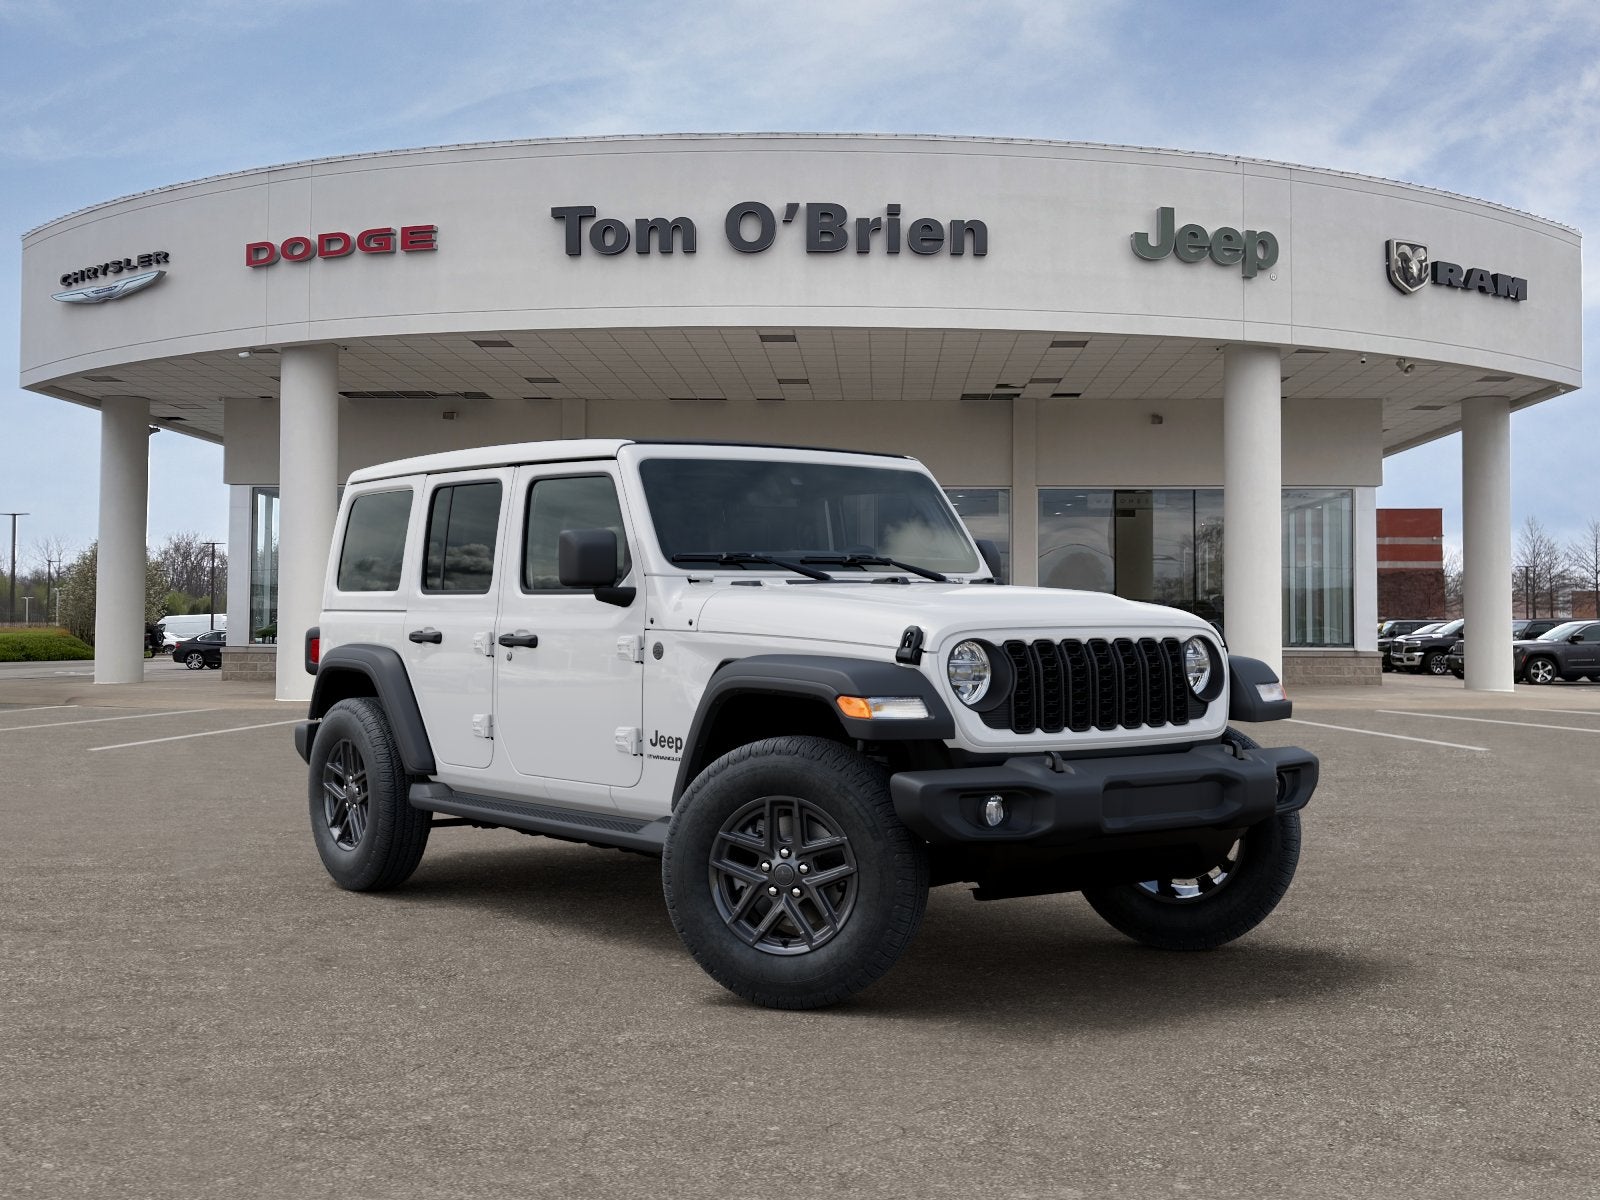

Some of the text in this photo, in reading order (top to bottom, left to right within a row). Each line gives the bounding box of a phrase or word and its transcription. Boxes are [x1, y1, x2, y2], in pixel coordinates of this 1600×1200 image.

[245, 224, 438, 269] DODGE
[551, 201, 988, 257] Tom O'Brien
[1131, 207, 1280, 278] Jeep
[59, 249, 170, 287] CHRYSLER
[1431, 260, 1528, 301] RAM
[649, 729, 683, 753] Jeep
